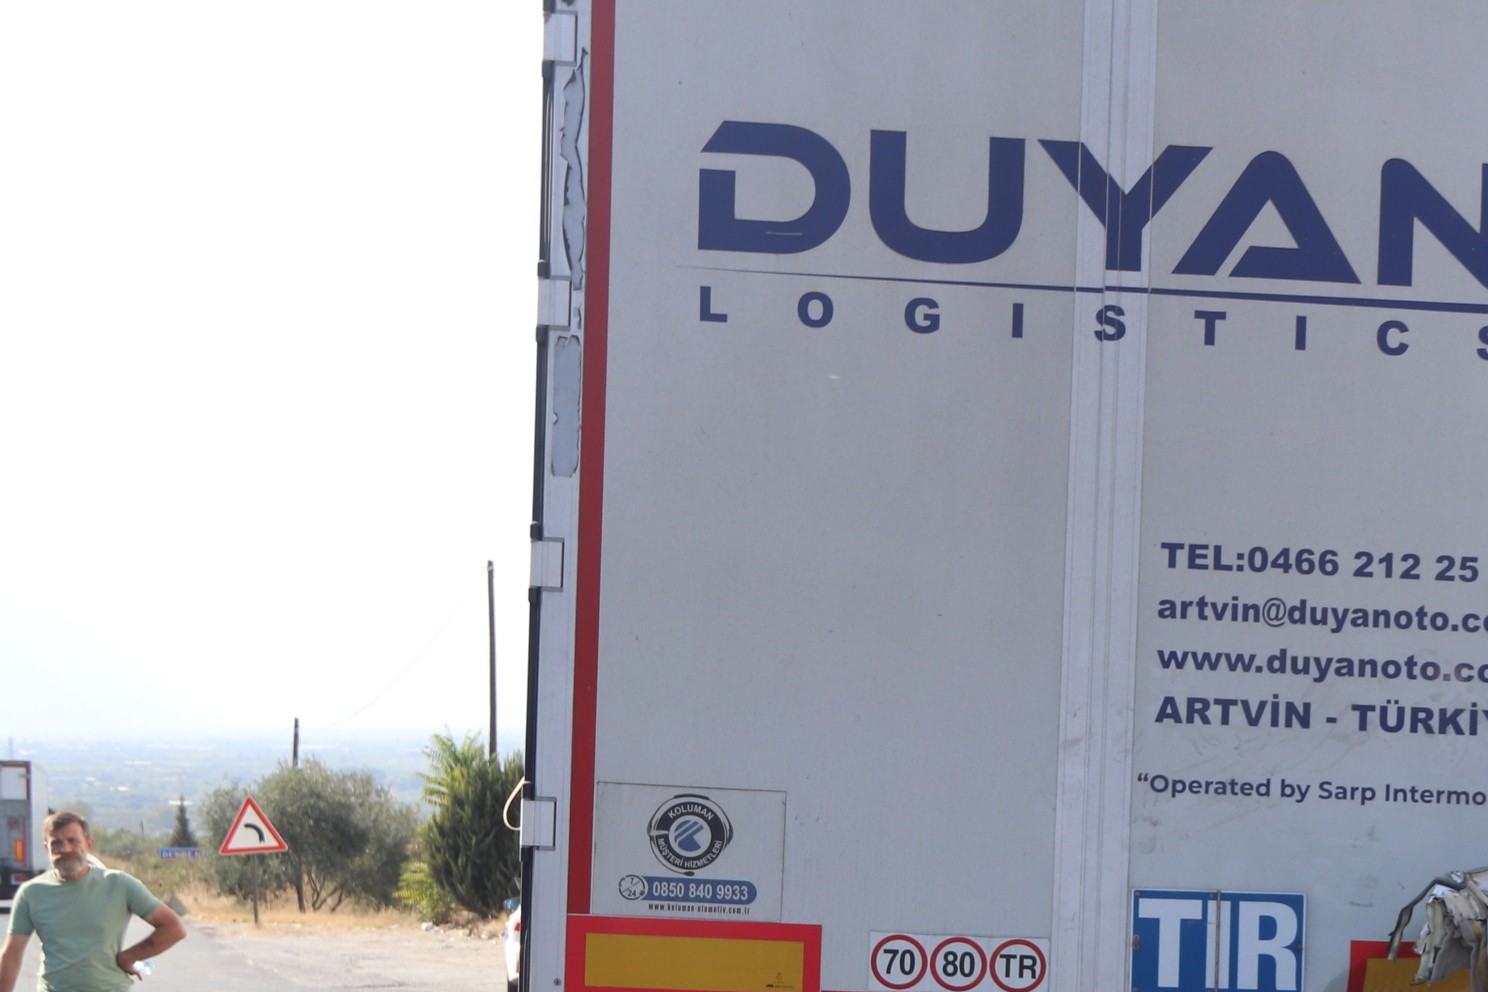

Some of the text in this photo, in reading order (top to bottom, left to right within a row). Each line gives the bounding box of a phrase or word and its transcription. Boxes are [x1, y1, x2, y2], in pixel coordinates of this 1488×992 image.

[1160, 542, 1340, 576] TEL:0466
[1352, 551, 1421, 580] 212
[1434, 555, 1479, 582] 25
[1154, 694, 1312, 729] ARTVİN
[1280, 778, 1311, 804] by
[1318, 781, 1376, 805] Sarp
[667, 803, 715, 821] KOLUMAN
[684, 840, 724, 869] HİZMETLERİ
[652, 881, 749, 901] 0850 840 9933
[1138, 897, 1299, 992] TIR
[883, 948, 916, 976] 70
[942, 950, 976, 978] 80
[999, 953, 1038, 980] TR
